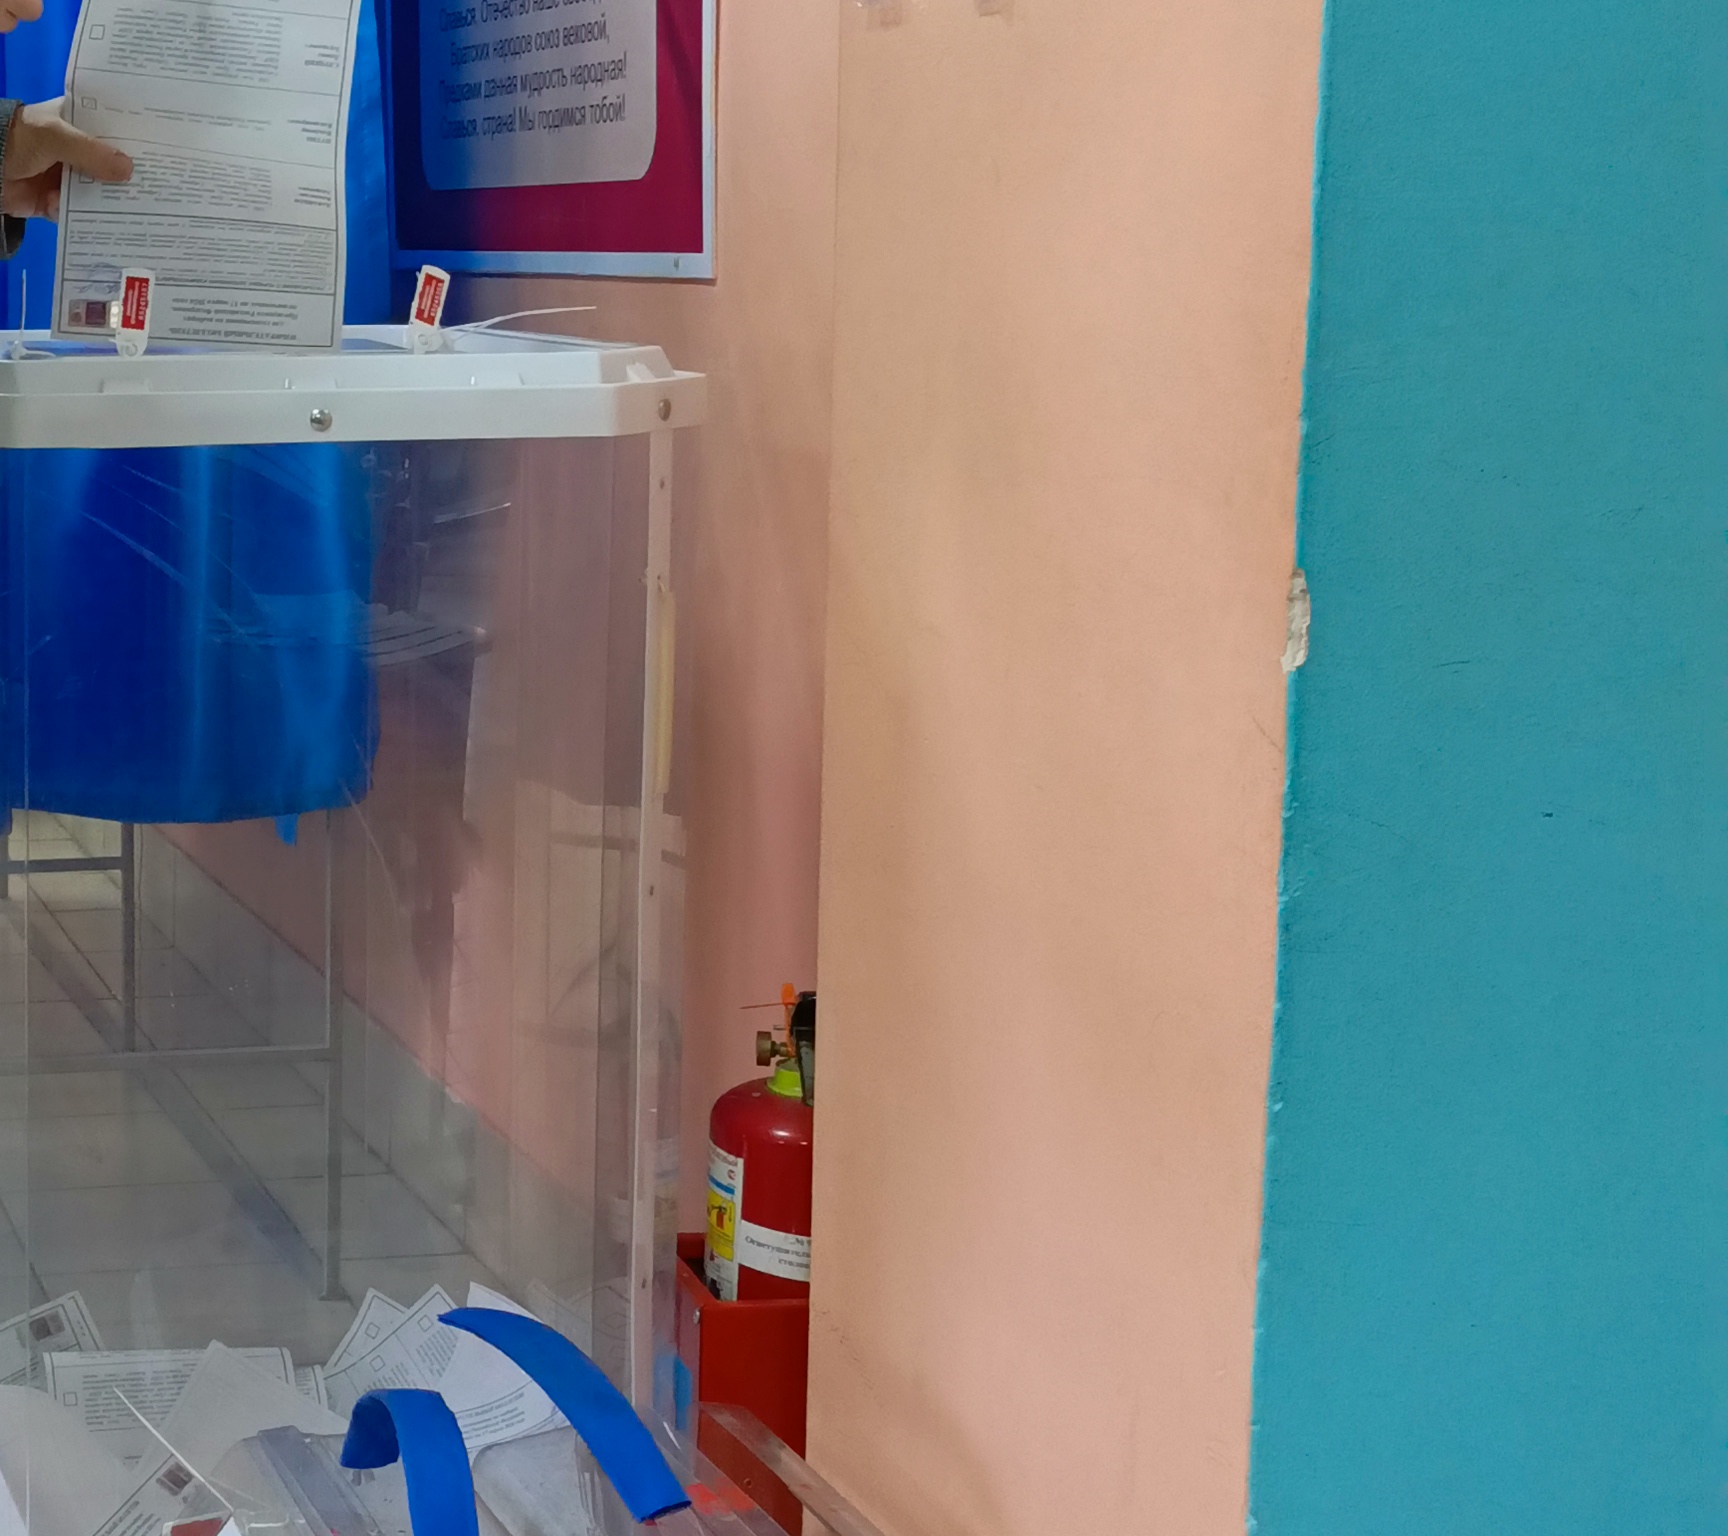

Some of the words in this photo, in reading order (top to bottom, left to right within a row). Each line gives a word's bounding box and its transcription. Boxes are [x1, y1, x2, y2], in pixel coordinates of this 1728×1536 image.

[449, 40, 490, 70] Братских
[492, 32, 533, 63] народов
[534, 26, 560, 52] союз
[562, 11, 610, 47] вековой,
[439, 79, 482, 106] Предками
[483, 75, 518, 100] данная
[520, 66, 568, 99] мудрость
[569, 50, 627, 92] народная!
[481, 106, 516, 141] страна!
[518, 105, 535, 132] Мы
[537, 107, 587, 135] гордимся
[588, 93, 626, 124] тобой!
